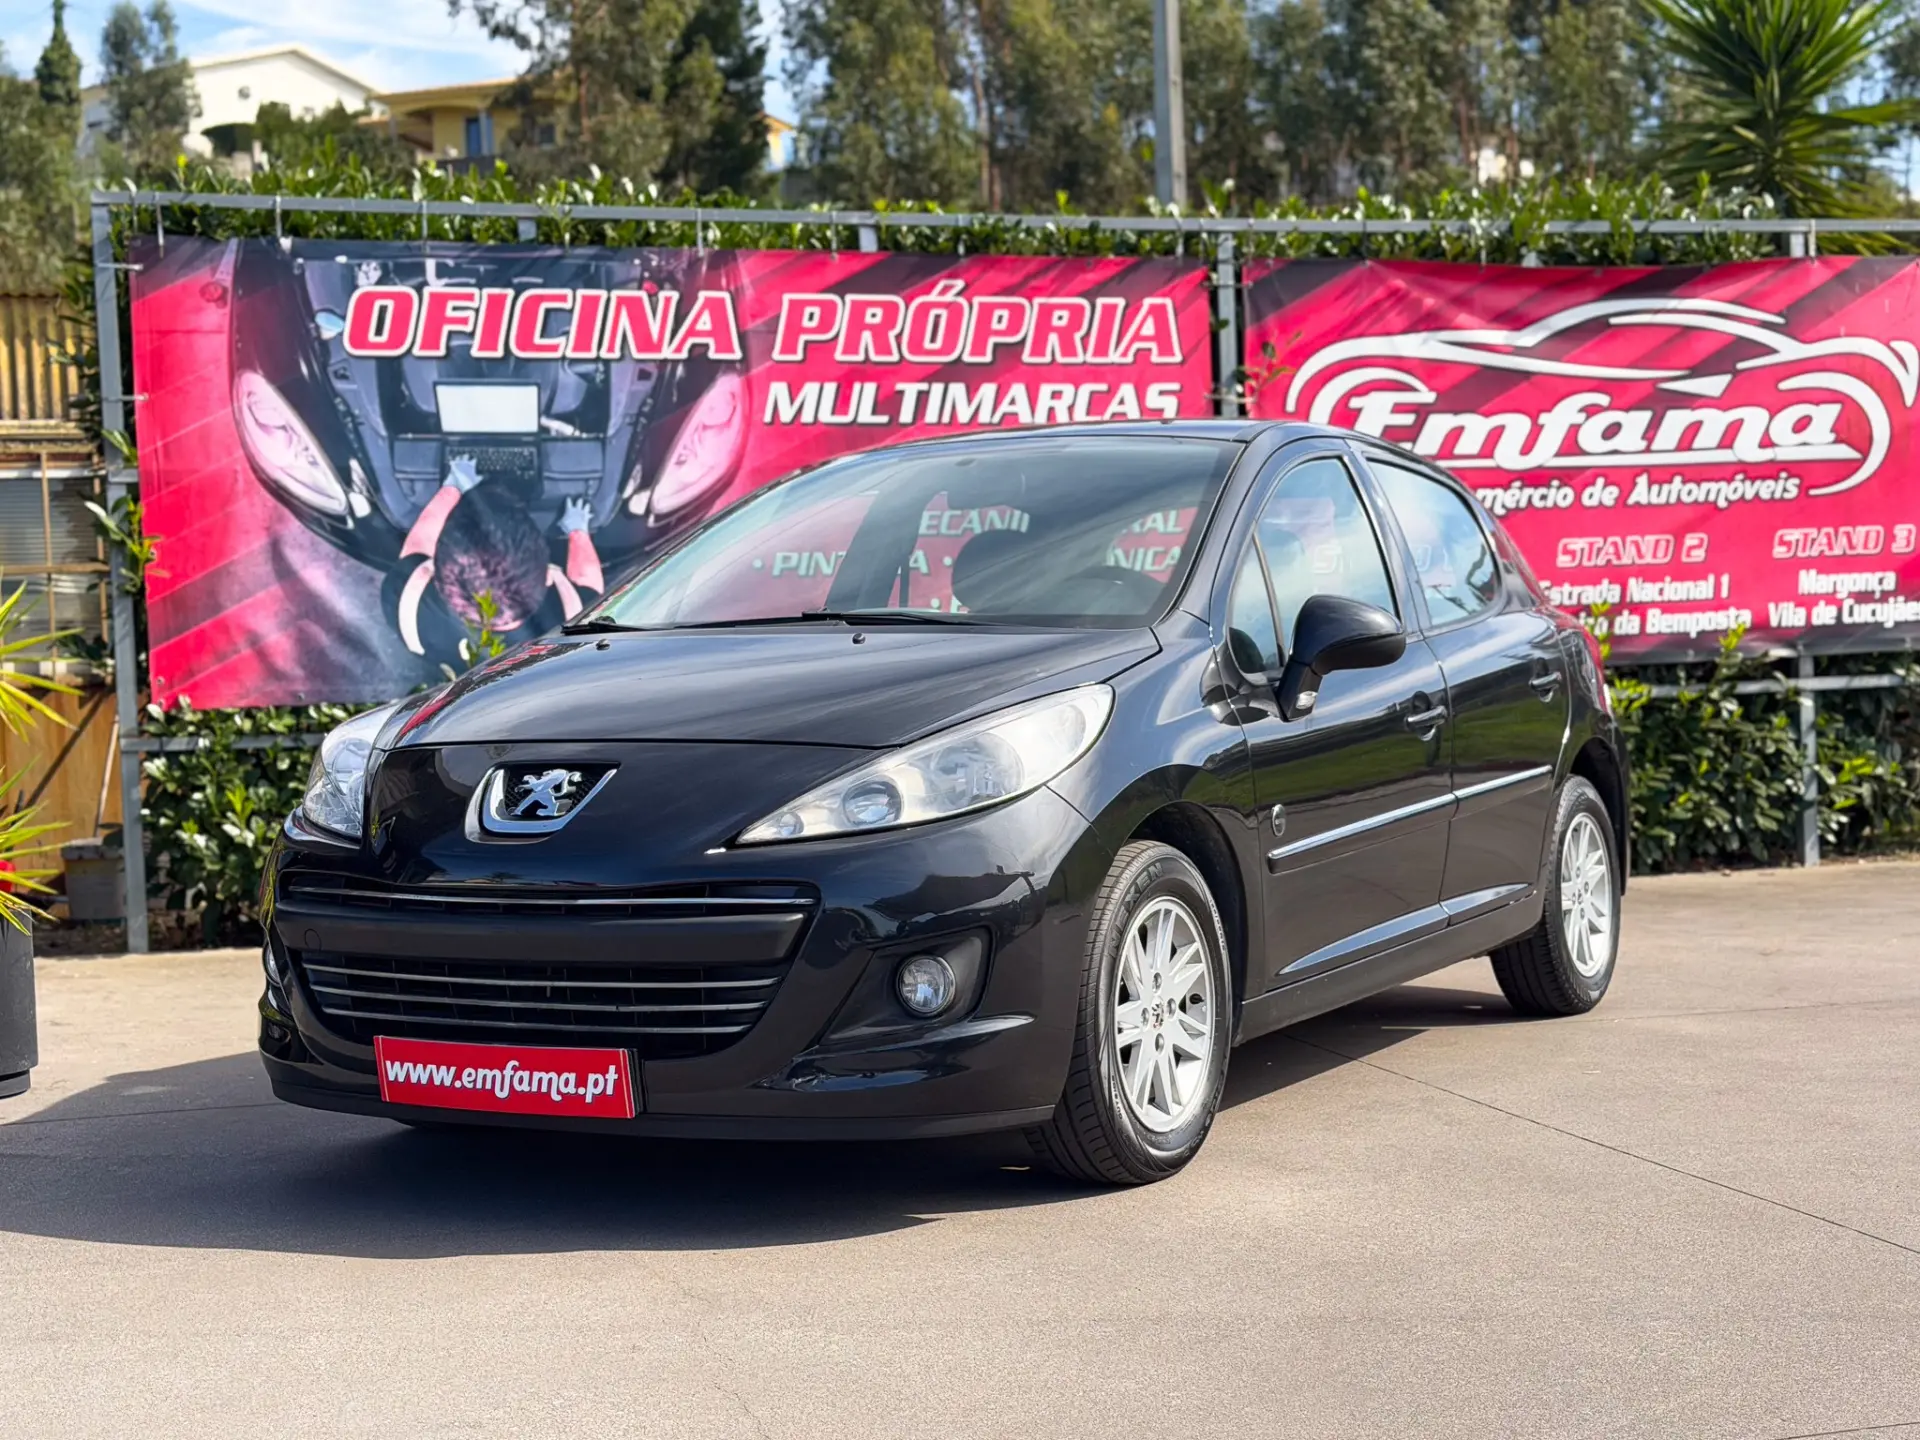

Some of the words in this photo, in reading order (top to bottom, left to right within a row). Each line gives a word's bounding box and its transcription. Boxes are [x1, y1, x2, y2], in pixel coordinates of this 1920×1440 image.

[343, 286, 743, 360] OFICINA
[772, 279, 1184, 364] PRÓPRIA
[763, 381, 1181, 425] MULTIMARCAS
[1347, 391, 1840, 470] Emfama
[1475, 479, 1575, 516] mércio
[1581, 476, 1619, 507] de
[1627, 471, 1800, 509] Automóveis
[1556, 534, 1674, 568] STAND
[1681, 532, 1708, 563] 2
[1772, 526, 1885, 559] STAND
[1891, 523, 1917, 553] 3
[1626, 572, 1715, 603] Nacional
[1721, 572, 1730, 599] 1
[1798, 569, 1896, 599] Margonça
[1613, 608, 1641, 636] da
[1645, 605, 1752, 639] Bemposta
[1768, 601, 1807, 628] Vila
[1811, 600, 1838, 626] de
[385, 1060, 618, 1103] www.emfama.pt
